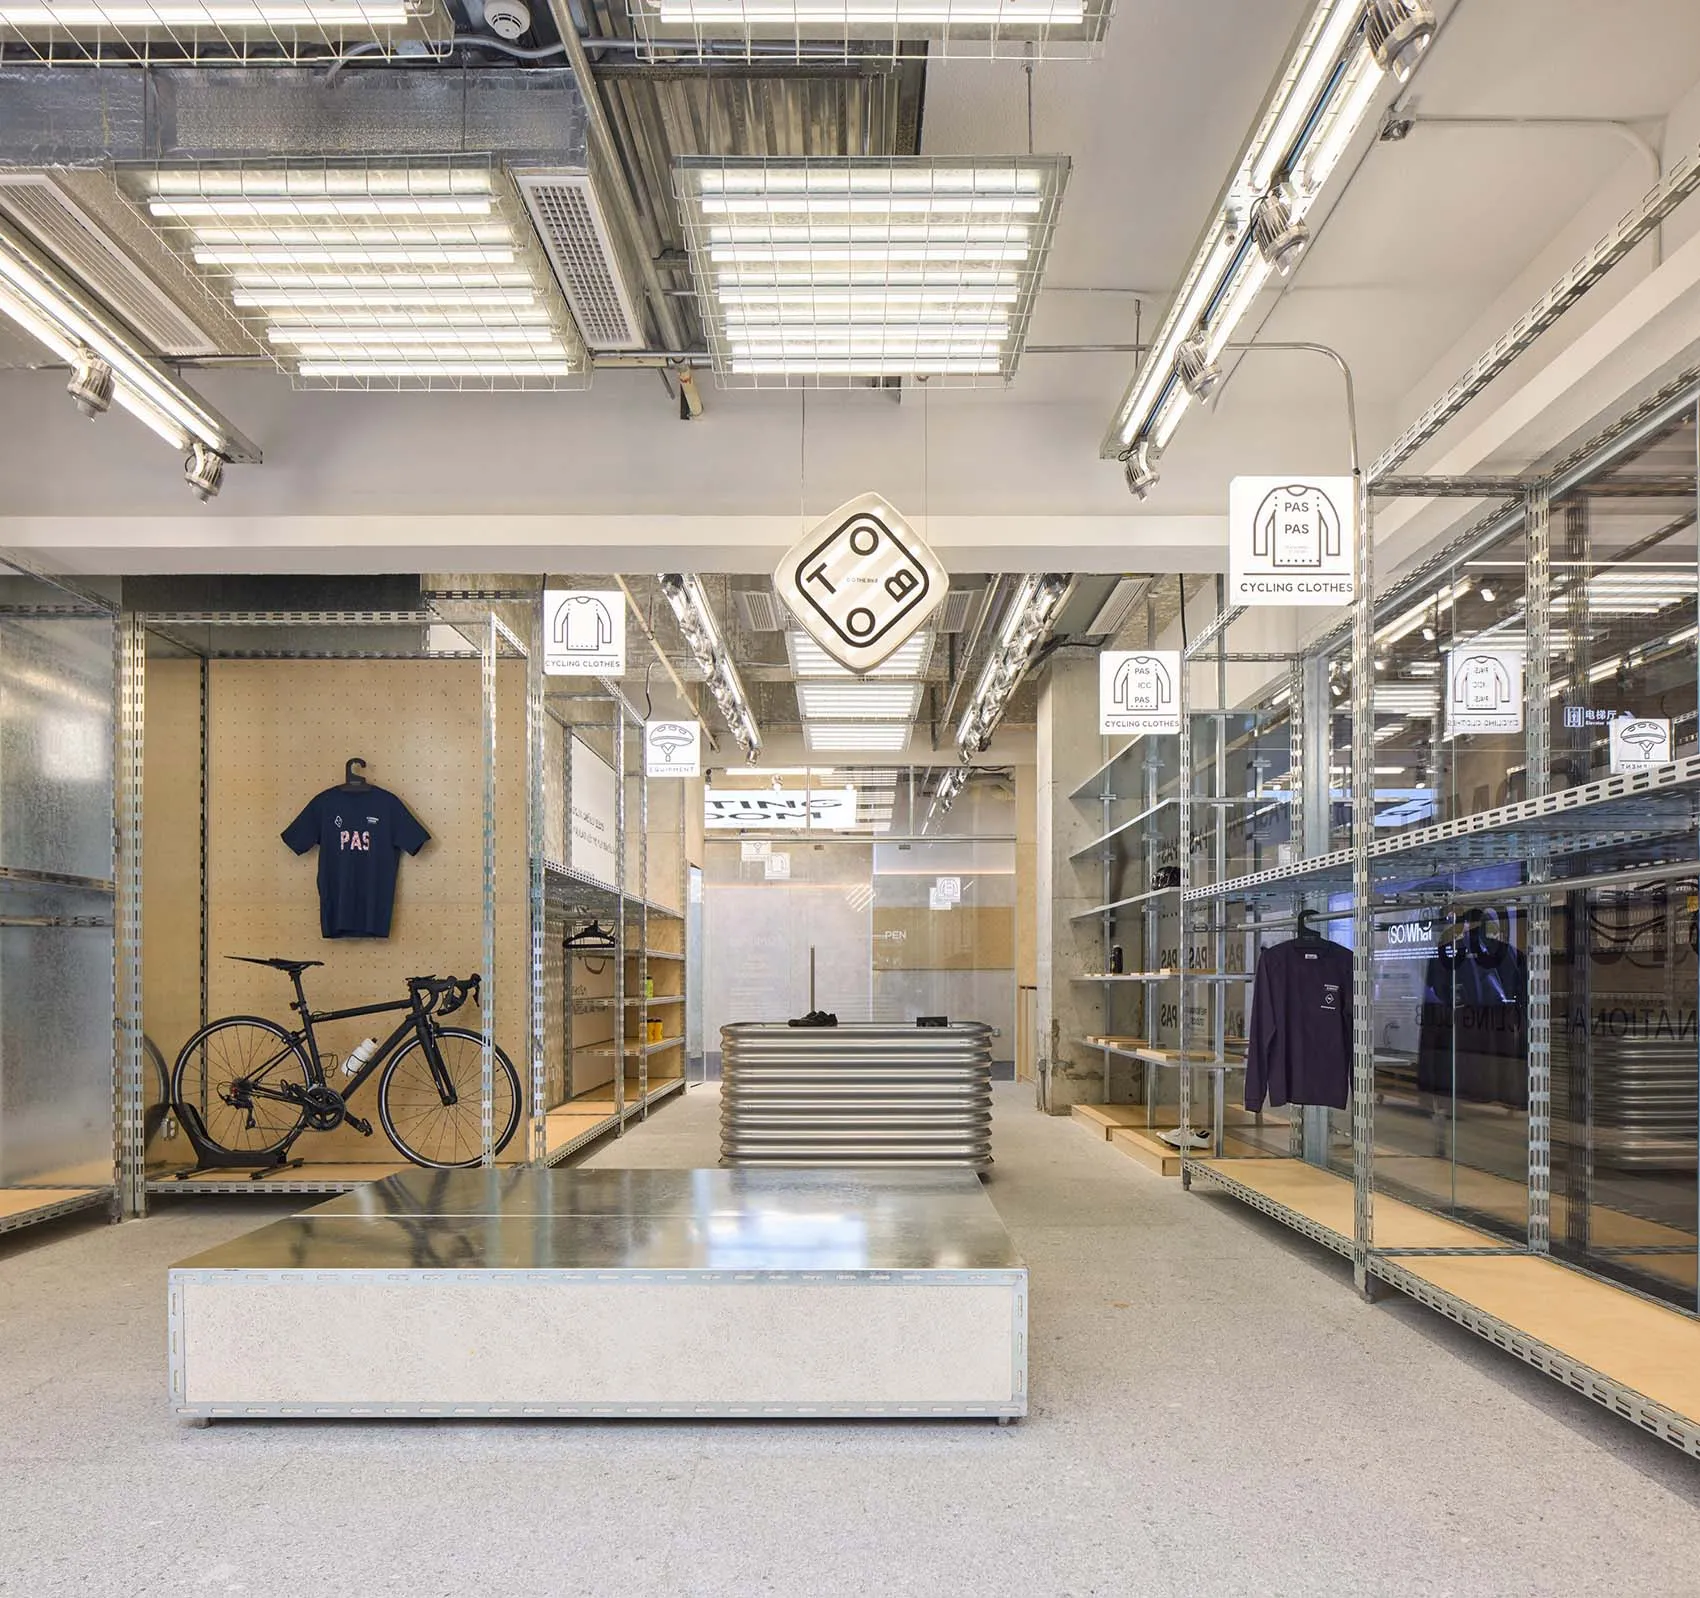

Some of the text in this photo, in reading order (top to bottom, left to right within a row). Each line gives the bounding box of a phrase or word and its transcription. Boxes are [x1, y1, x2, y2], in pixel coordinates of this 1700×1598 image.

[1284, 502, 1309, 513] PAS
[1284, 523, 1309, 535] PAS
[1240, 582, 1353, 593] CYCLING CLOTHES
[582, 660, 620, 668] CLOTHES
[1134, 667, 1150, 675] PAS
[1585, 709, 1617, 720] 电梯厅
[1105, 720, 1180, 728] CYCLING CLOTHES
[340, 830, 370, 851] PAS
